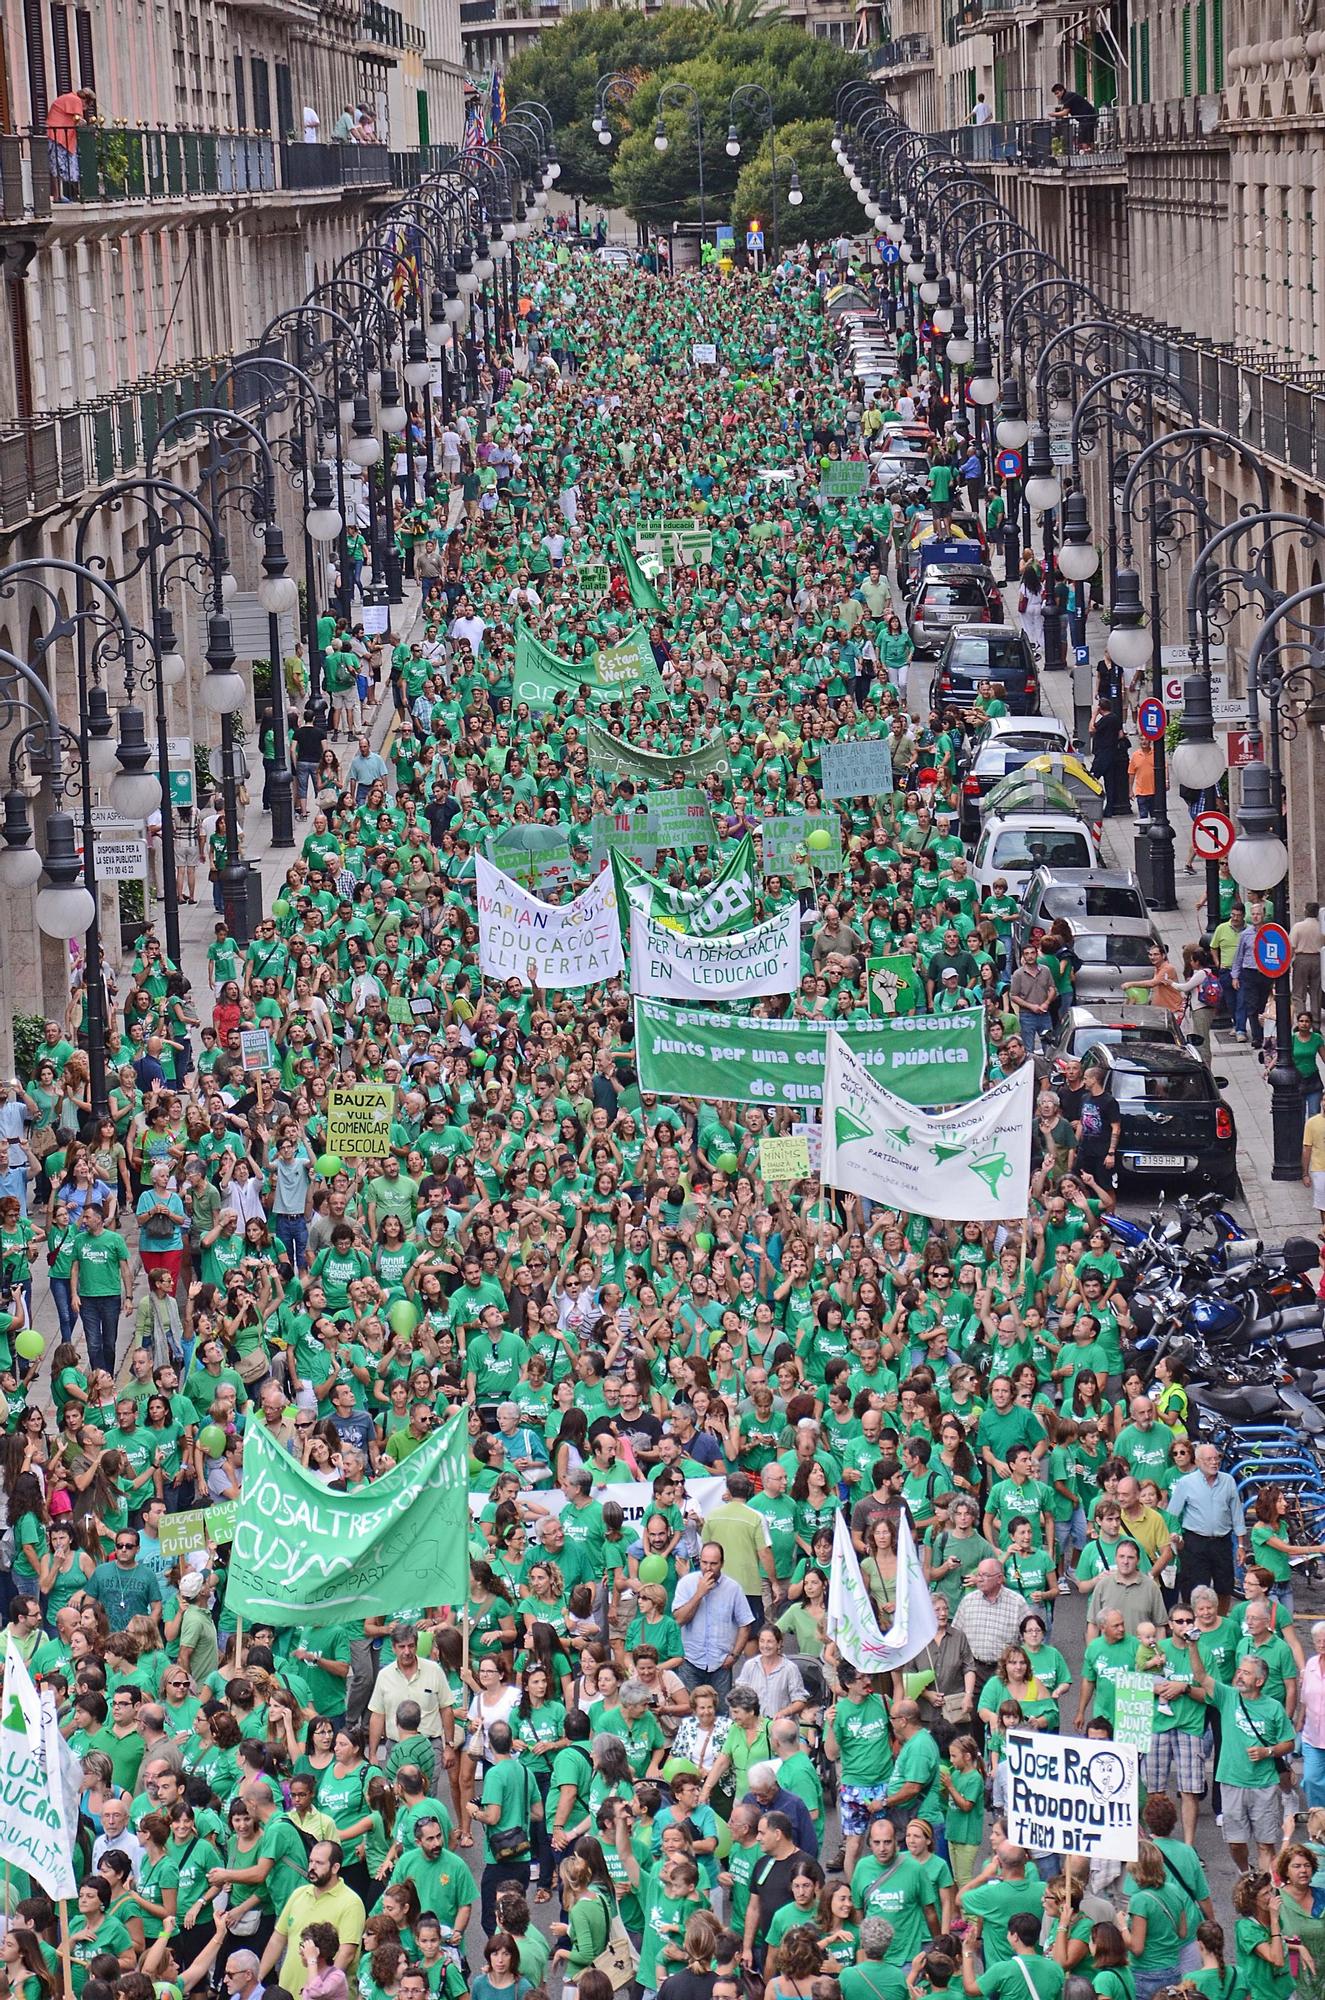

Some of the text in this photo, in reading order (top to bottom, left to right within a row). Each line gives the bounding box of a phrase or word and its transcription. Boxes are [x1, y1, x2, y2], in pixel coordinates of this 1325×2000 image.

[600, 668, 639, 682] Werts
[116, 855, 142, 864] PUBLICITAT
[479, 895, 548, 929] MARIAN
[648, 936, 670, 956] PER
[675, 943, 693, 961] LA
[1269, 945, 1276, 957] P
[651, 961, 672, 980] EN
[675, 1010, 732, 1028] pares
[652, 1035, 706, 1058] junts
[710, 1045, 746, 1062] per
[752, 1049, 790, 1064] una
[892, 1047, 969, 1069] pública
[750, 1078, 776, 1097] de
[333, 1092, 387, 1108] BAUZÀ
[347, 1110, 374, 1120] VULL
[330, 1138, 386, 1154] L'ESCOLA
[205, 1502, 239, 1520] EDUCA
[241, 1468, 385, 1539] VOSALTRES
[162, 1534, 204, 1554] FUTUR
[1008, 1734, 1059, 1782] JOSE
